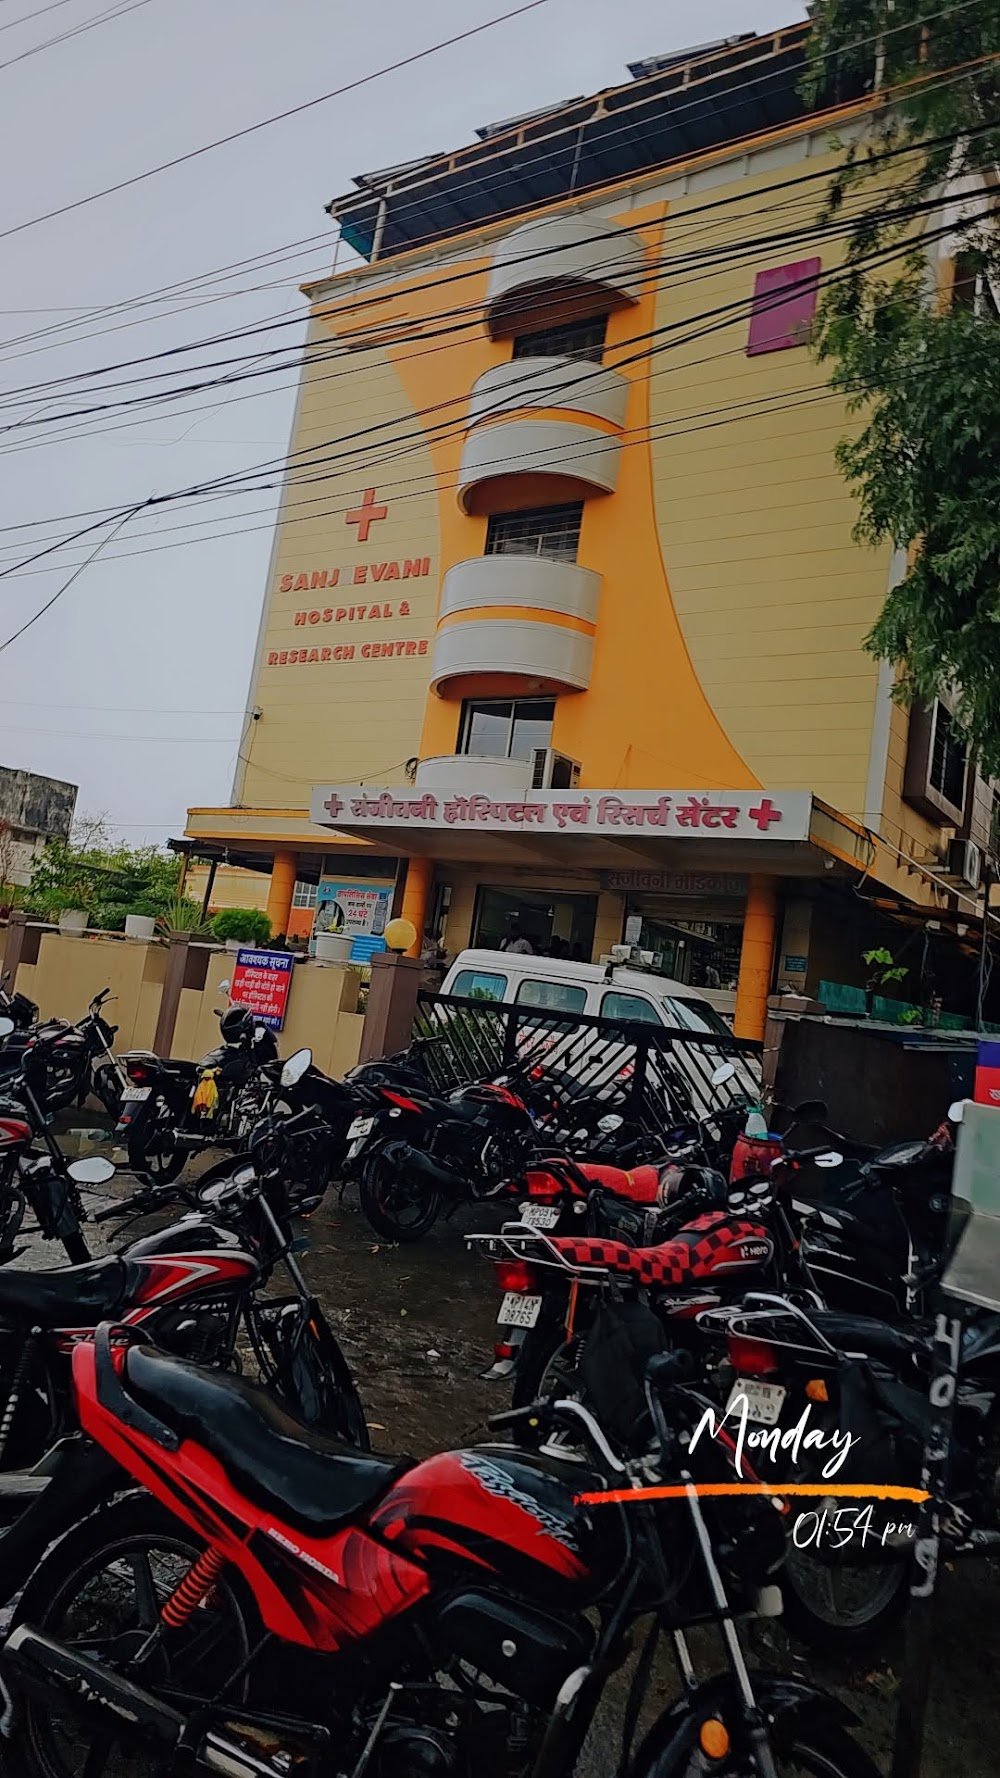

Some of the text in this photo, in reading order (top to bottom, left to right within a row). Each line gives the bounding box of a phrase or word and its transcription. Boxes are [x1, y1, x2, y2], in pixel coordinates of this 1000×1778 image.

[294, 601, 411, 626] HOSPITAL &
[267, 640, 429, 666] RESEARCH CENTRE
[350, 792, 740, 828] संजीवनी हॉस्पिटल एवं रिसर्च सेंटर
[358, 909, 368, 918] घंटे
[240, 953, 289, 970] आवश्यक सूचना
